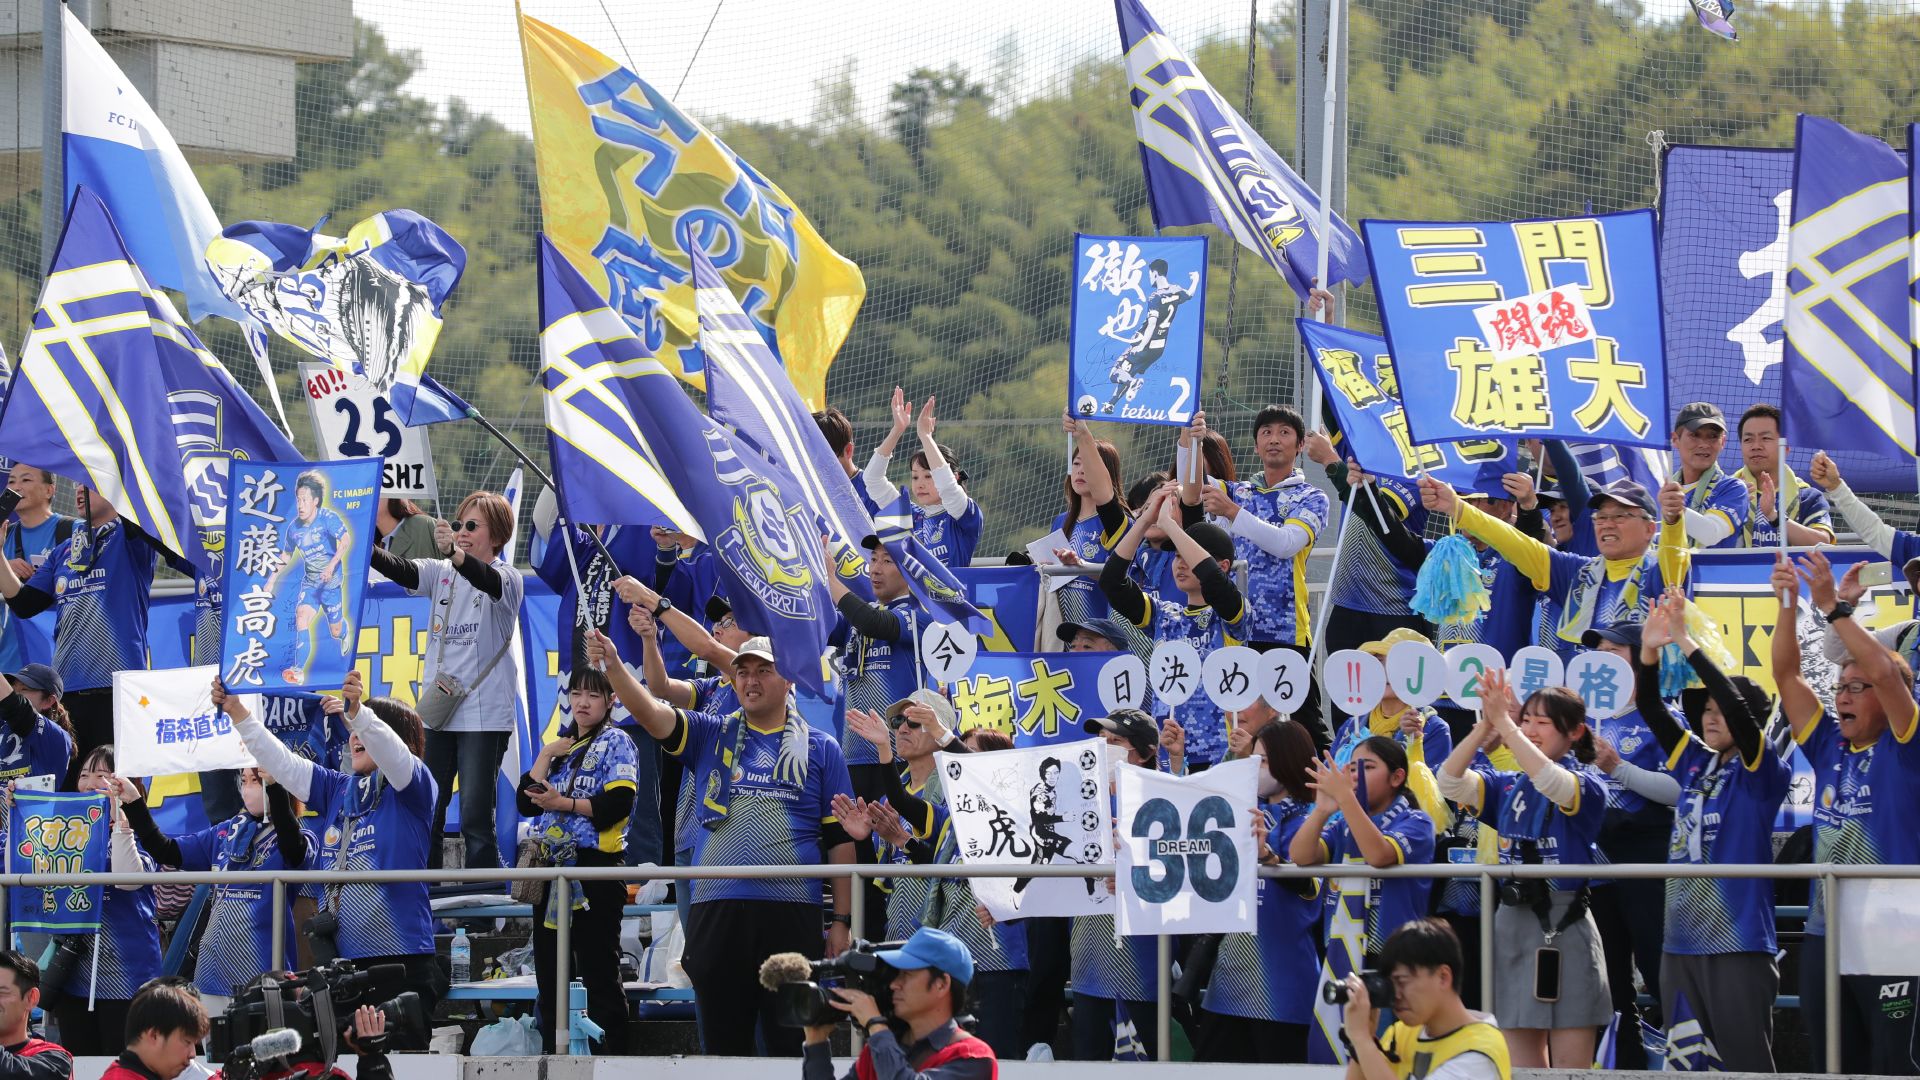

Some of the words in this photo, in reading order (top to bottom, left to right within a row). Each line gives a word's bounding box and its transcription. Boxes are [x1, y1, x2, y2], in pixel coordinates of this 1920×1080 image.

[108, 111, 126, 126] FC
[1397, 218, 1614, 309] 三門
[1080, 240, 1147, 344] 徹也
[307, 369, 348, 400] GO!!
[1122, 403, 1168, 422] tetsu
[1167, 376, 1191, 423] 2
[1448, 337, 1651, 433] 雄大
[334, 396, 402, 458] 25
[333, 490, 343, 499] FC
[344, 487, 374, 499] IMABARI
[346, 501, 361, 511] MF9
[225, 468, 288, 687] 近藤高虎
[953, 657, 1083, 740] 梅木
[155, 712, 232, 744] 福森直也
[358, 775, 372, 803] 9
[738, 786, 755, 796] Your
[756, 788, 800, 801] Possibilities
[955, 793, 993, 814] 近藤
[1511, 790, 1527, 823] 4
[24, 816, 92, 853] くすみ
[965, 838, 984, 859] 高
[984, 804, 1032, 858] 虎
[1158, 840, 1211, 854] DREAM
[1130, 795, 1239, 904] 36
[66, 891, 92, 911] くん
[225, 891, 262, 900] Possibilities
